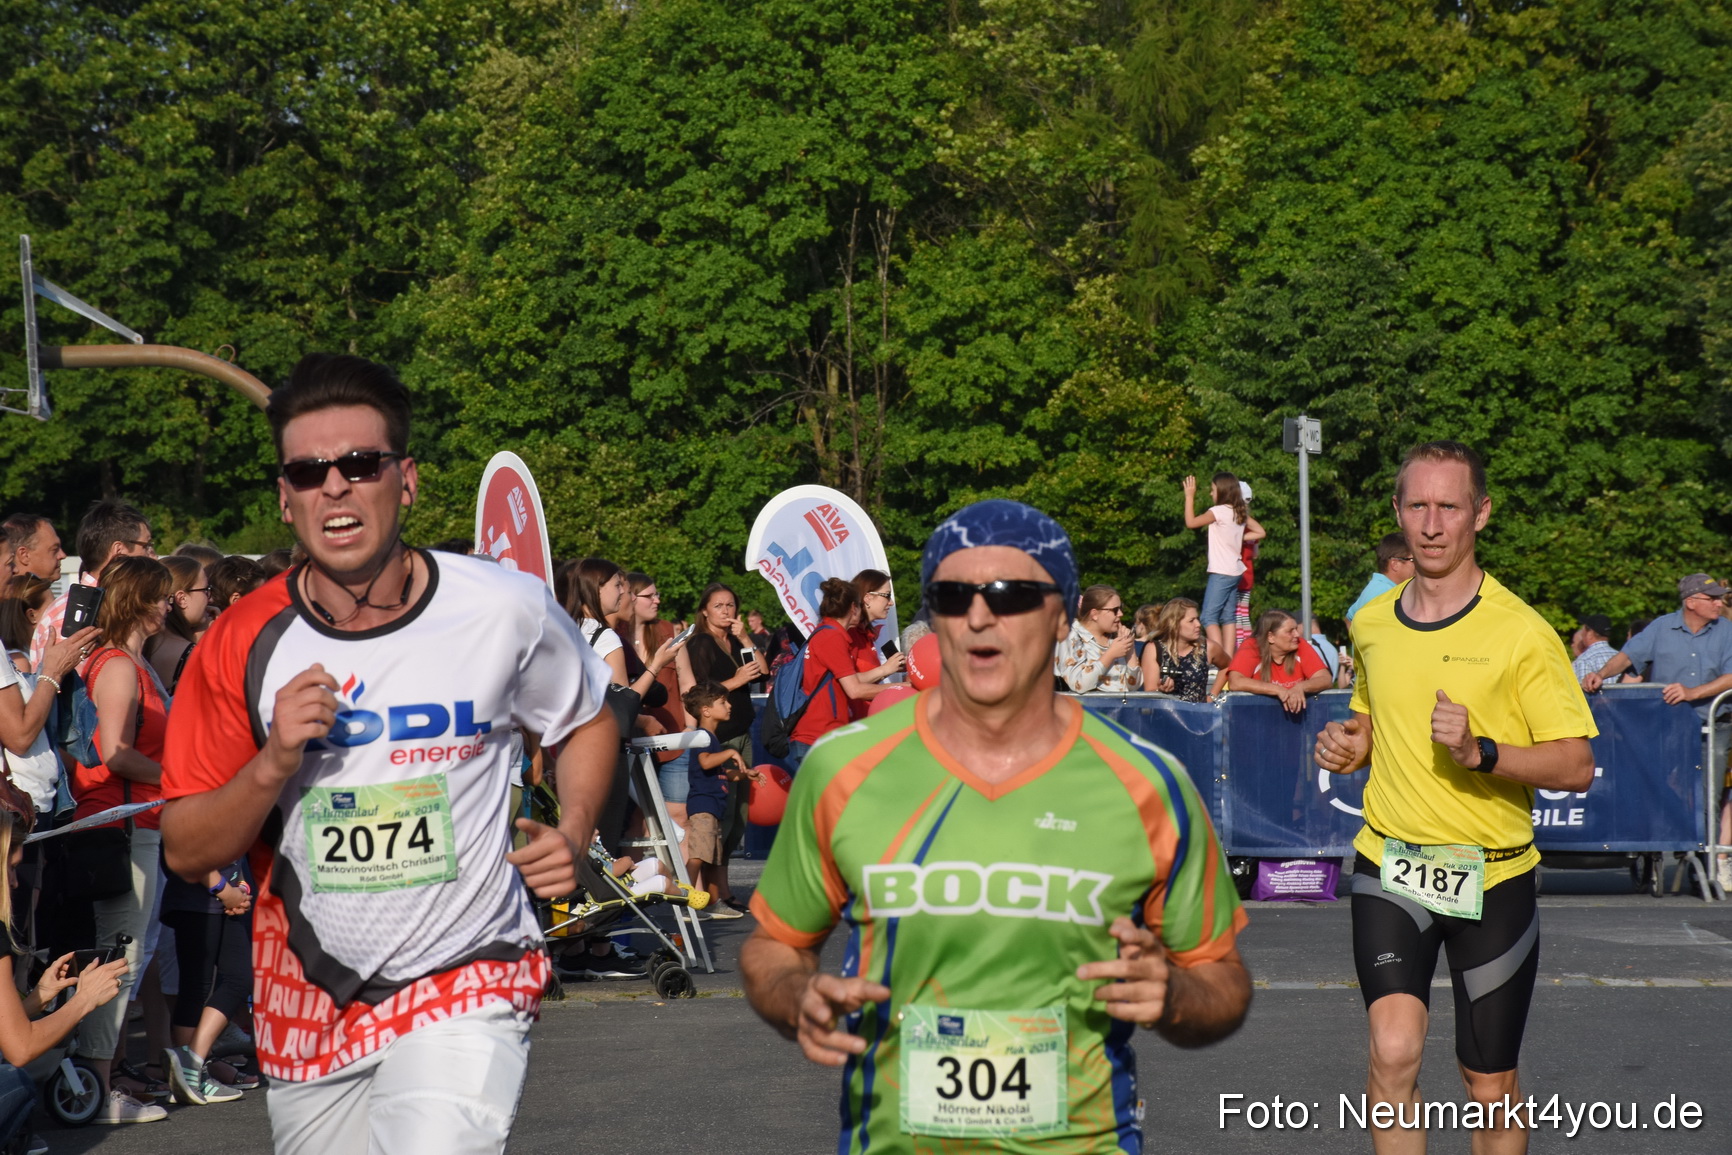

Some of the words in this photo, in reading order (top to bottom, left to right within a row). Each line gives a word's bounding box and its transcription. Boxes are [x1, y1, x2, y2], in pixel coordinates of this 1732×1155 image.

[414, 803, 440, 815] 2019
[322, 816, 434, 863] 2074
[317, 862, 398, 874] Markovinovitsch
[401, 854, 447, 869] Christian
[1392, 858, 1469, 896] 2187
[862, 861, 1114, 926] BOCK
[1436, 893, 1459, 904] André
[936, 1056, 1031, 1101] 304
[938, 1103, 981, 1115] Hörner
[986, 1104, 1030, 1114] Nikolai
[965, 1117, 993, 1125] GmbH
